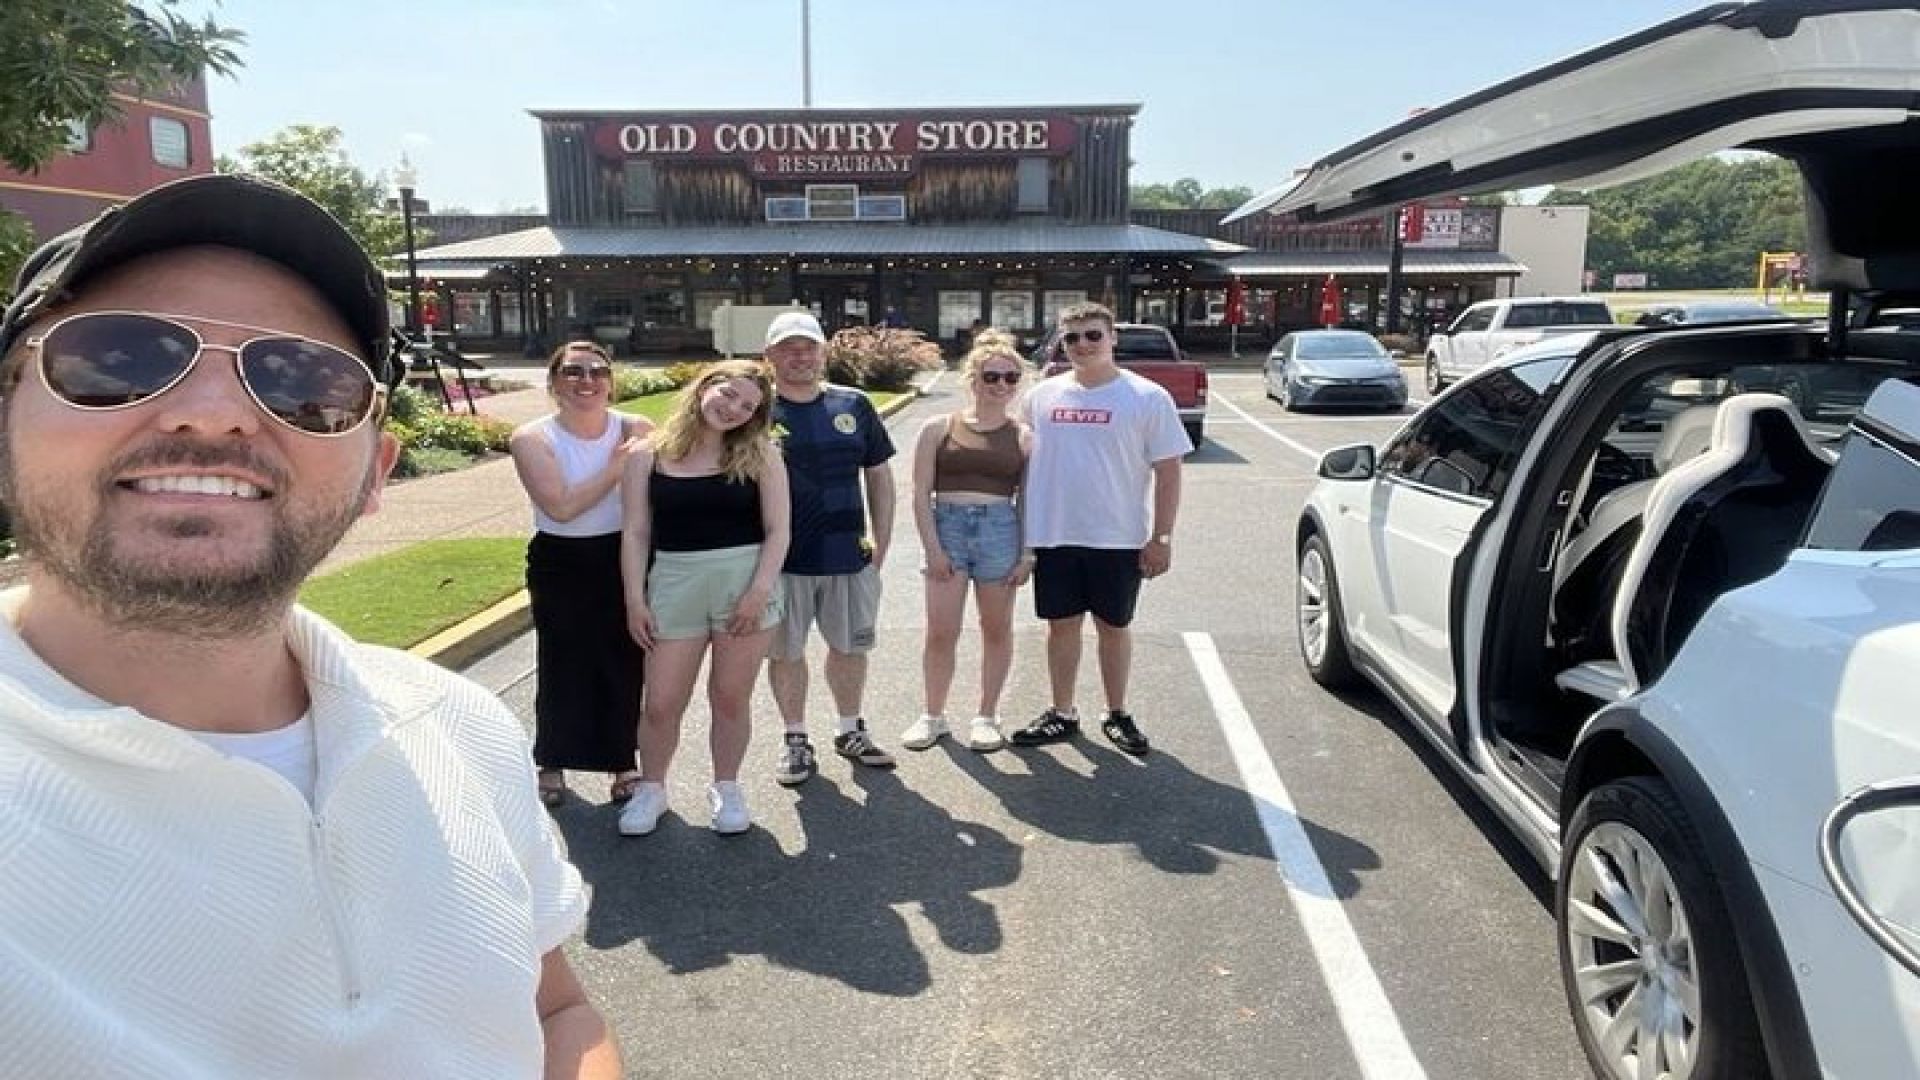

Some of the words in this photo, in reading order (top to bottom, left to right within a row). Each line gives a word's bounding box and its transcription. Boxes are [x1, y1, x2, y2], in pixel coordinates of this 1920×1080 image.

[619, 124, 697, 153] OLD
[714, 123, 899, 152] COUNTRY
[916, 120, 1048, 150] STORE
[778, 154, 913, 172] RESTAURANT
